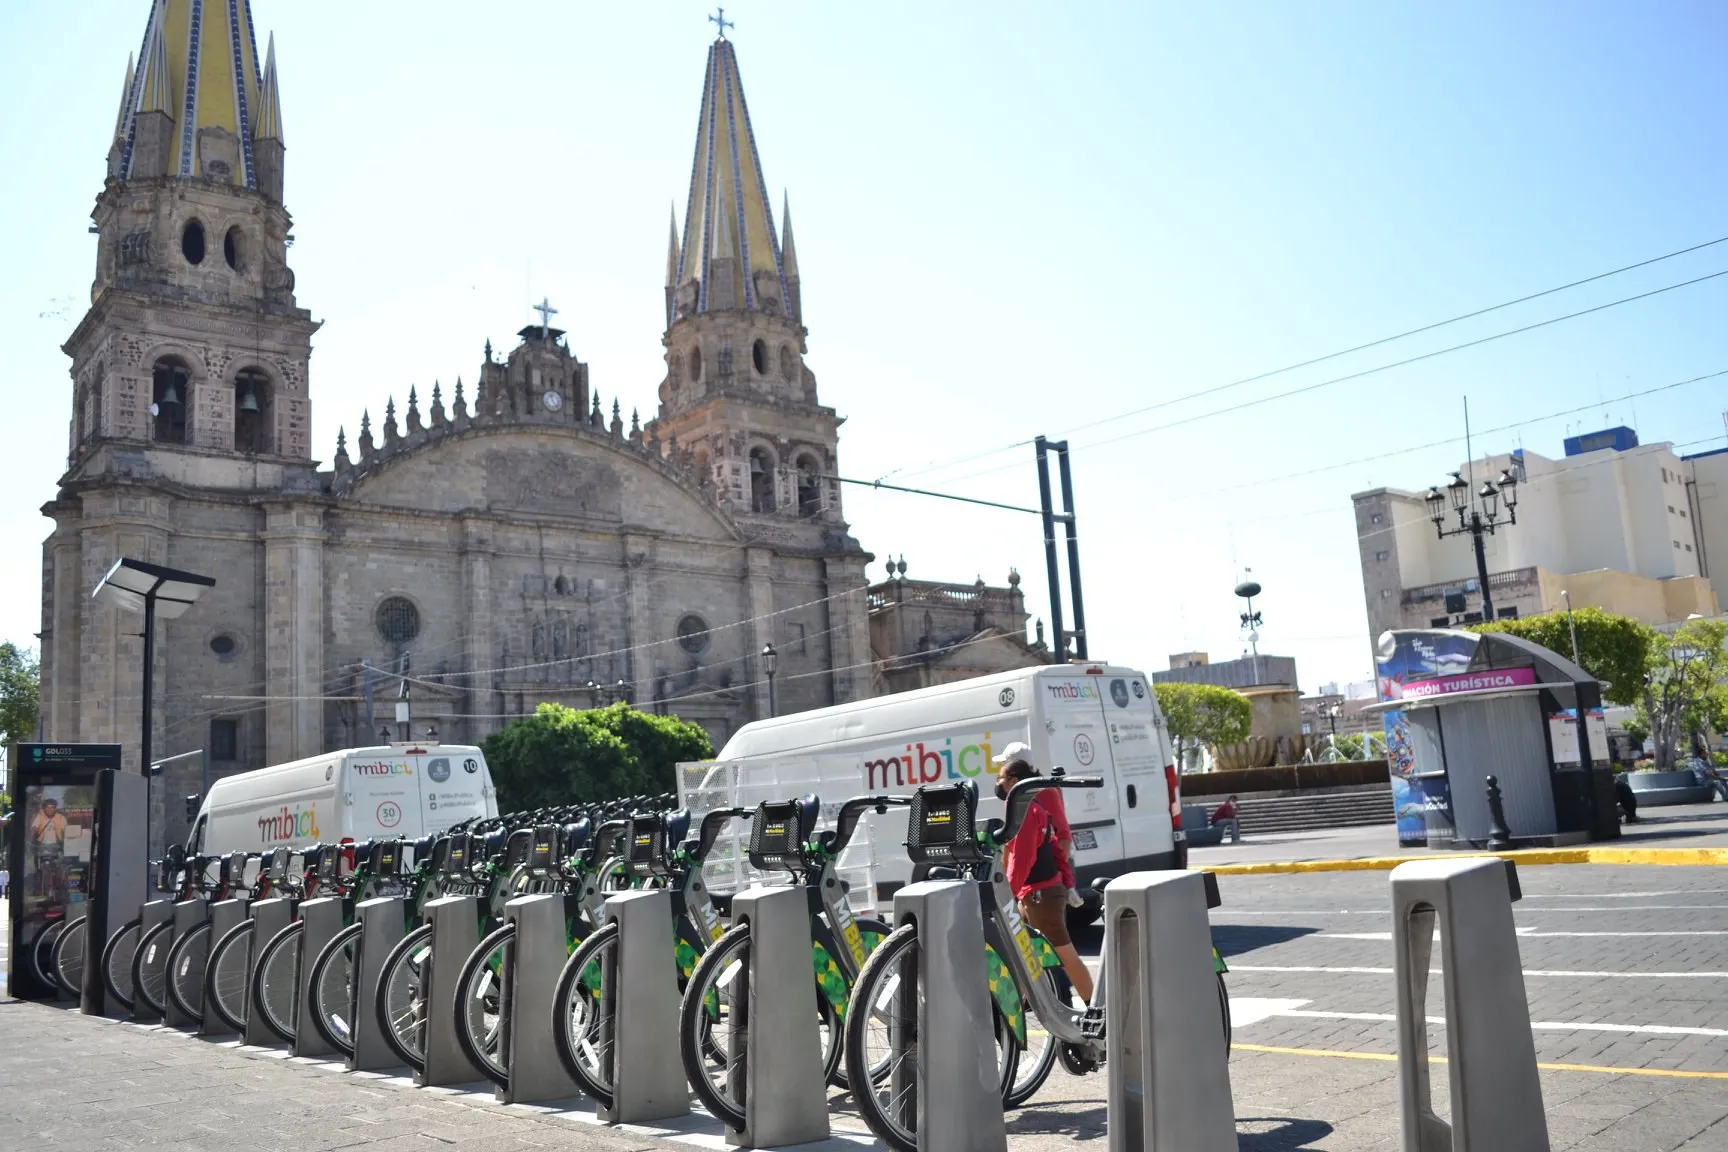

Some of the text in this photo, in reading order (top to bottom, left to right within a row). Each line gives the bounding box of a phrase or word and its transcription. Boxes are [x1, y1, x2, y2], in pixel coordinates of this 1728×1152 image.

[1443, 675, 1515, 692] TURÍSTICA
[1000, 691, 1015, 704] 08
[464, 761, 476, 771] 10
[865, 731, 1002, 790] mibici
[354, 761, 412, 776] mibici
[382, 808, 395, 818] 30
[258, 800, 320, 843] mibici
